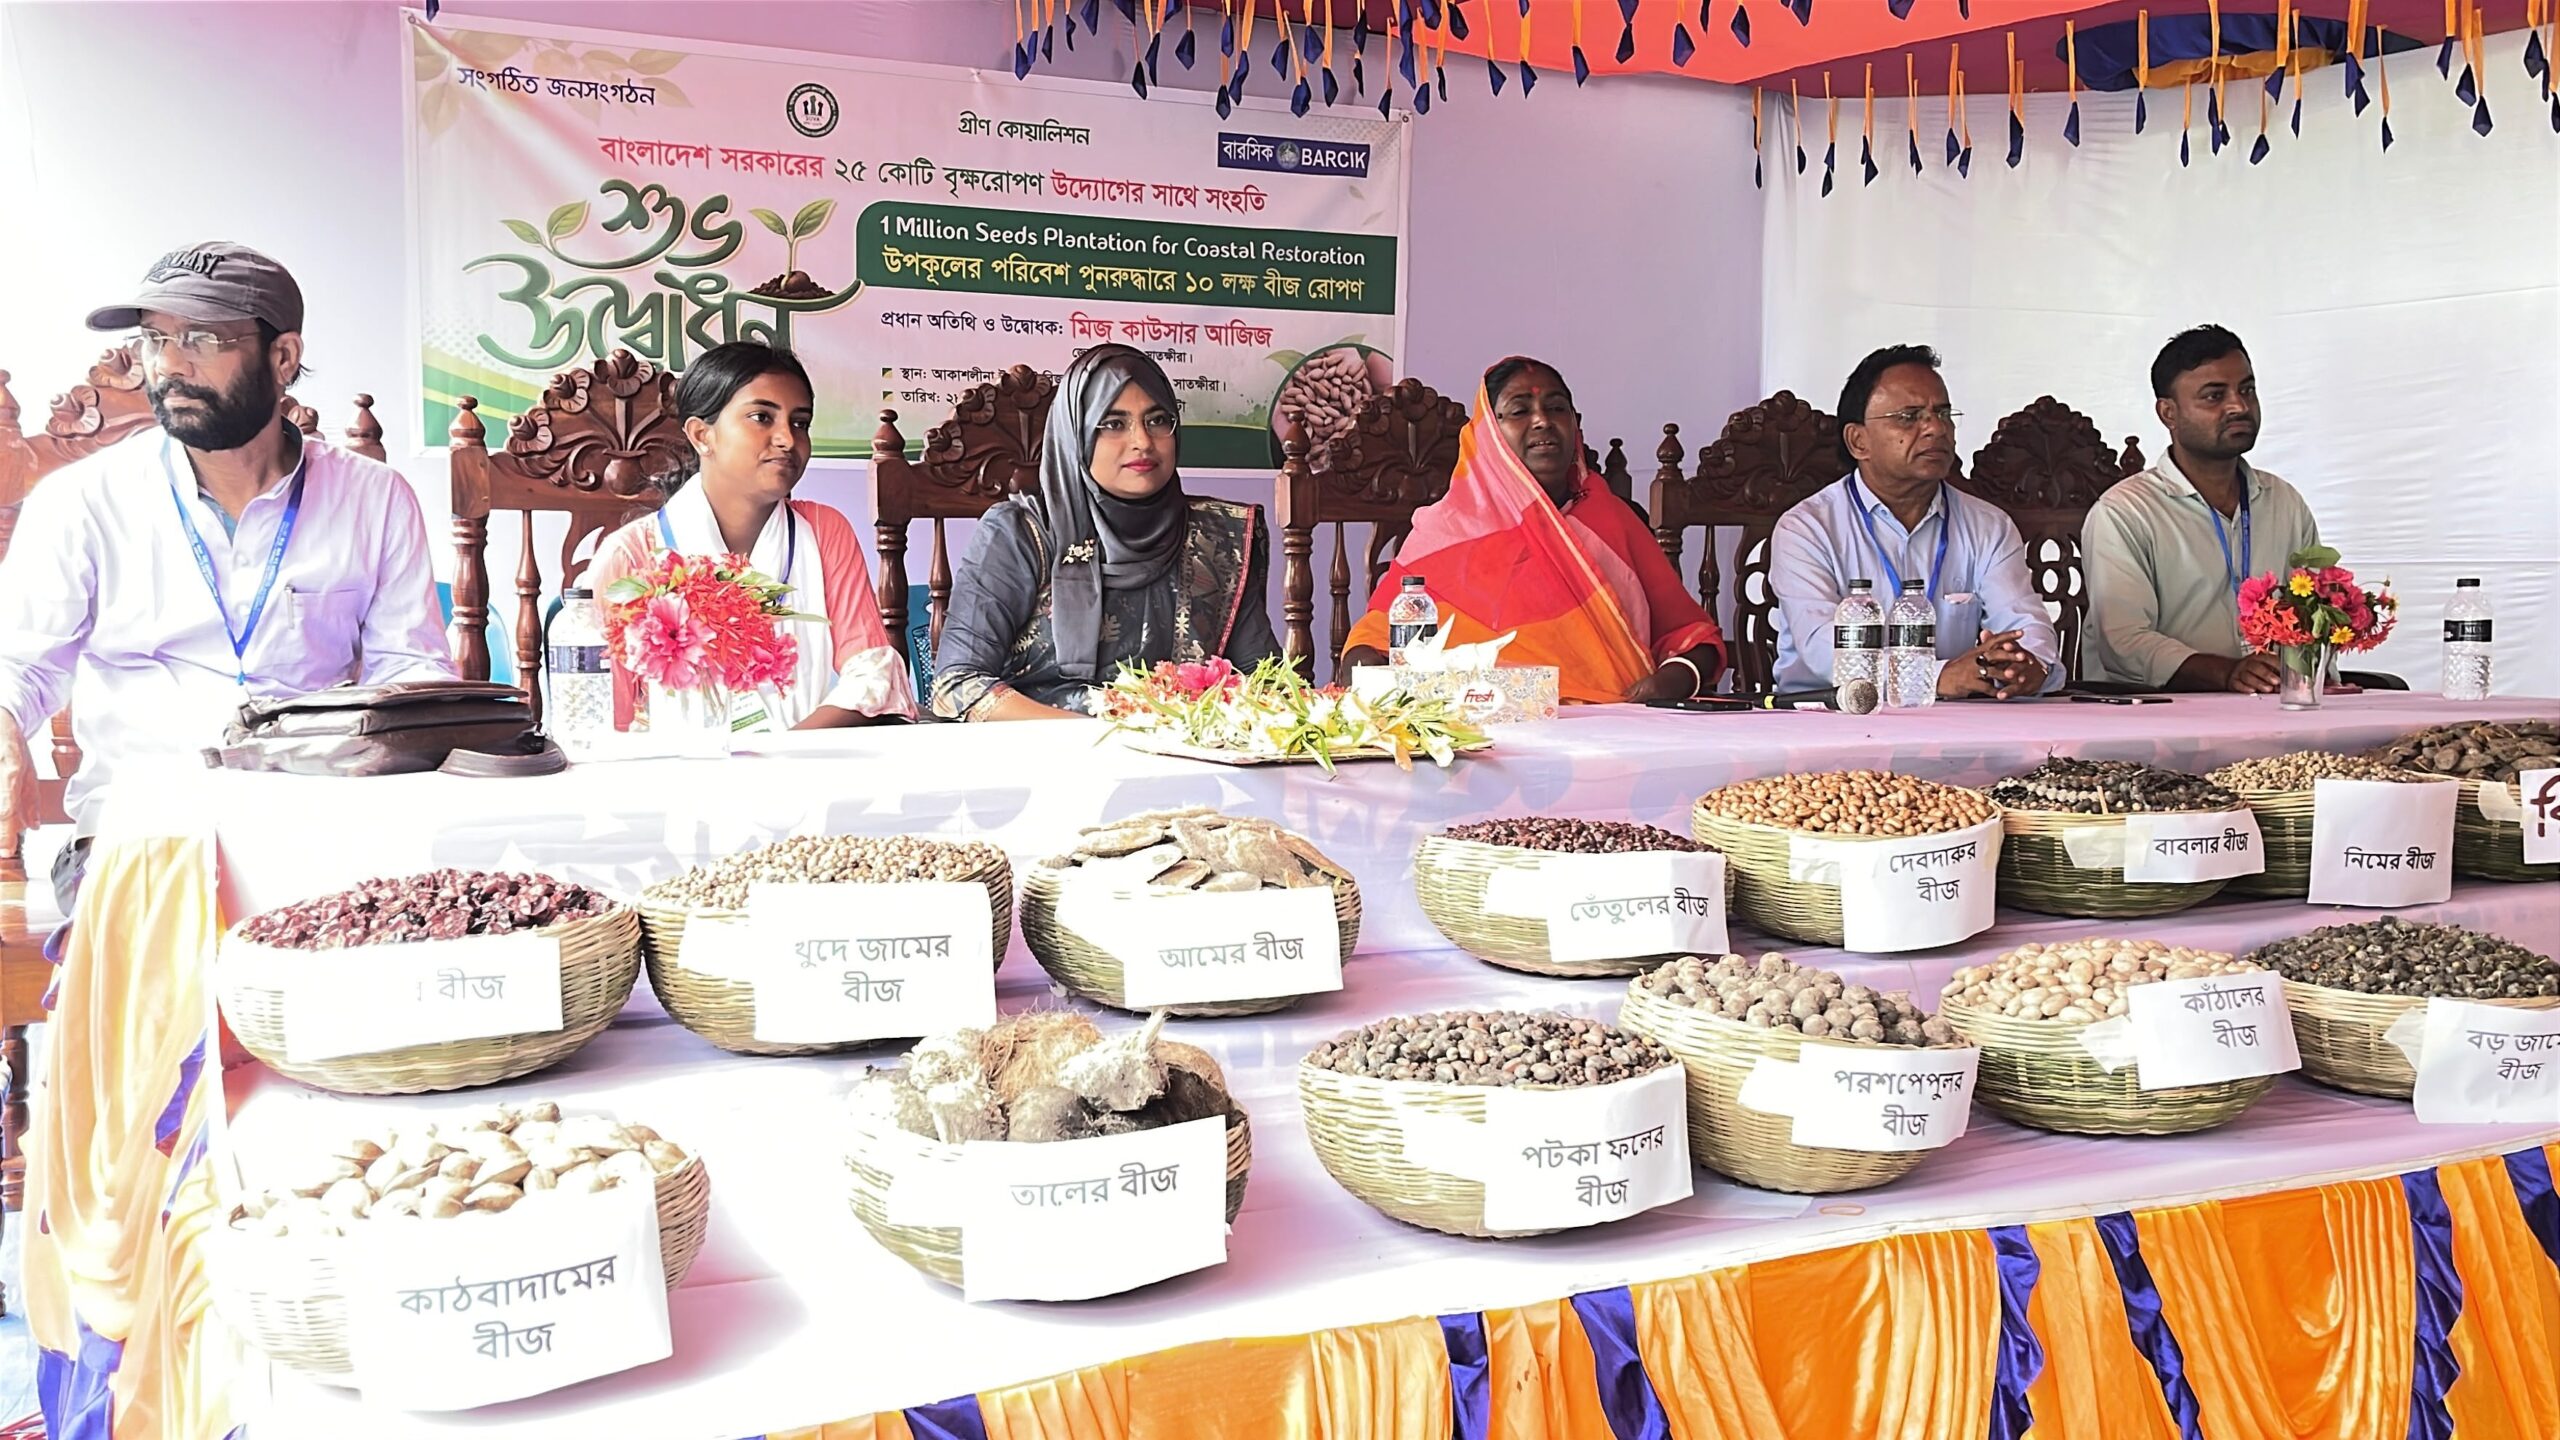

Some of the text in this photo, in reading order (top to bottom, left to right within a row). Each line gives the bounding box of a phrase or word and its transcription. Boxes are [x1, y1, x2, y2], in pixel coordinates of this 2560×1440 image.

[457, 66, 655, 105] সংগঠিত জনসংগঠন
[958, 111, 1090, 145] গ্রীণ কোয়ালিশন
[1222, 137, 1274, 162] বারসিক
[1301, 148, 1366, 169] BARCIK
[598, 136, 1268, 215] বাংলাদেশ সরকারের ২৫ কোটি বৃক্ষরোপণ উদ্যোগের সাথে সংহতি
[555, 178, 746, 271] শুভ
[880, 215, 1365, 266] 1 Million Seeds Plantation for Coastal Restoration
[882, 244, 1365, 301] উপকূলের পরিবেশ পুনরুদ্ধারে ১০ লক্ষ বীজ রোপণ
[463, 253, 865, 374] উদ্বোধন
[881, 312, 922, 328] প্রধান
[927, 310, 977, 331] অতিথি
[983, 318, 995, 331] ও
[1120, 315, 1199, 344] কাউসার
[1204, 319, 1273, 347] আজিজ
[1464, 689, 1494, 703] Fresh
[1890, 841, 1976, 873] দেবদারুর
[2154, 828, 2249, 856] বাবলার বীজ
[2344, 846, 2437, 869] নিমের বীজ
[1571, 887, 1709, 924] তেঁতুলের বীজ
[1916, 877, 1960, 902] বীজ
[795, 935, 952, 968] খুদে জামের
[1158, 931, 1304, 968] আমের বীজ
[436, 967, 506, 1001] বীজ
[841, 971, 904, 1003] বীজ
[2180, 983, 2265, 1013] কাঁঠালের
[2212, 1019, 2259, 1048] বীজ
[2466, 1030, 2510, 1055] বড়
[2497, 1058, 2545, 1080] বীজ
[1881, 1104, 1929, 1136] বীজ
[1522, 1125, 1665, 1168] পটকা ফলের
[1010, 1162, 1180, 1208] তালের বীজ
[1576, 1175, 1629, 1207] বীজ
[396, 1255, 618, 1316] কাঠবাদামের
[474, 1321, 556, 1360] বীজ
